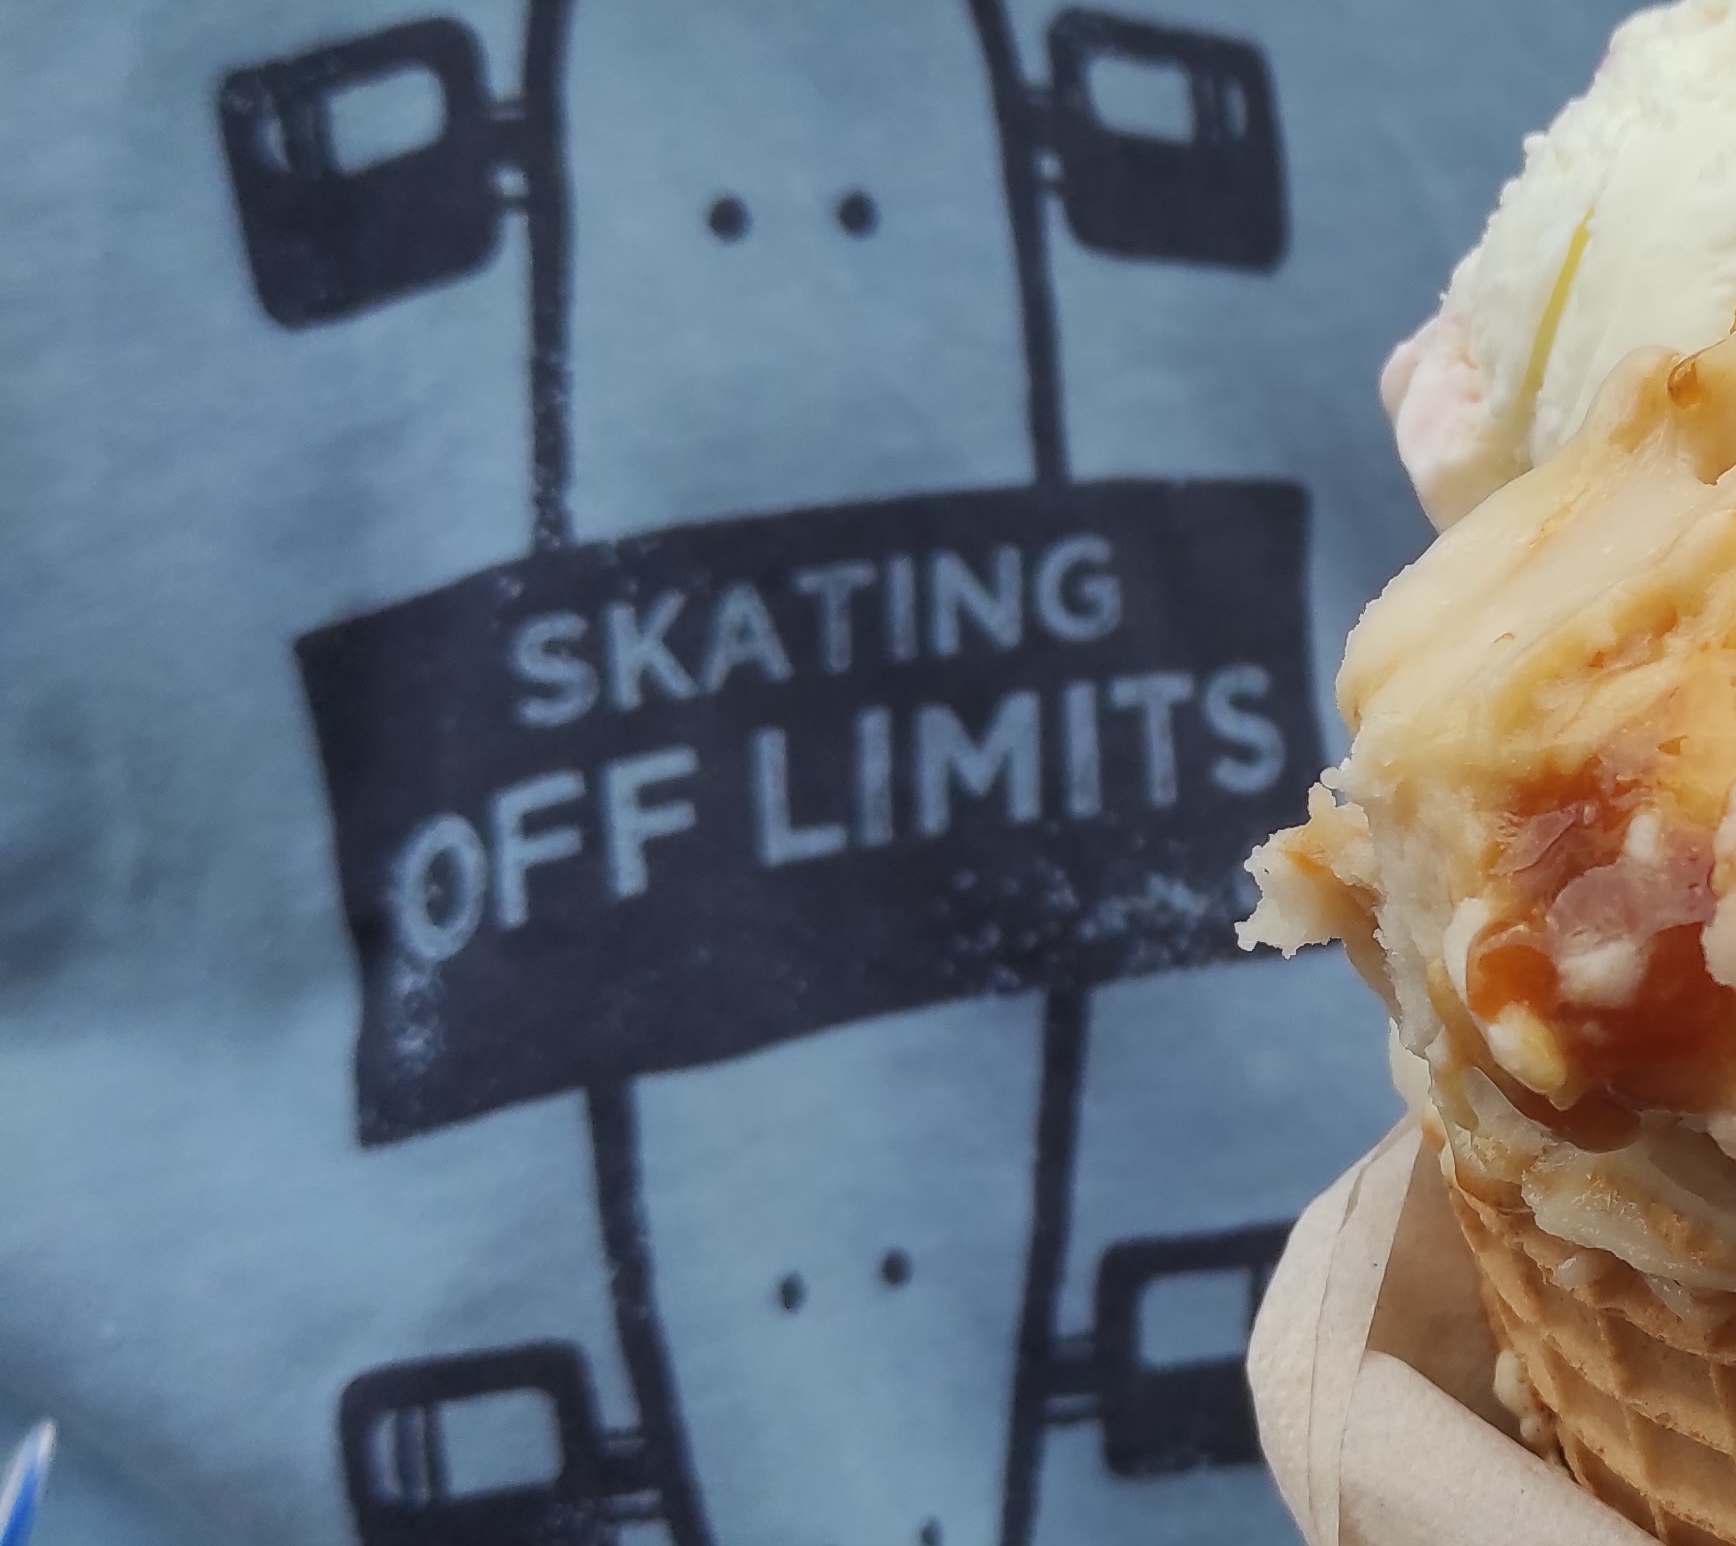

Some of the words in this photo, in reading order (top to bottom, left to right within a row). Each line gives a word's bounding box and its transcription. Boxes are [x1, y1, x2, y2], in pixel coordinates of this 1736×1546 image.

[512, 533, 1124, 730] SKATING
[391, 745, 698, 965] OFF
[755, 664, 1287, 867] LIMITS
